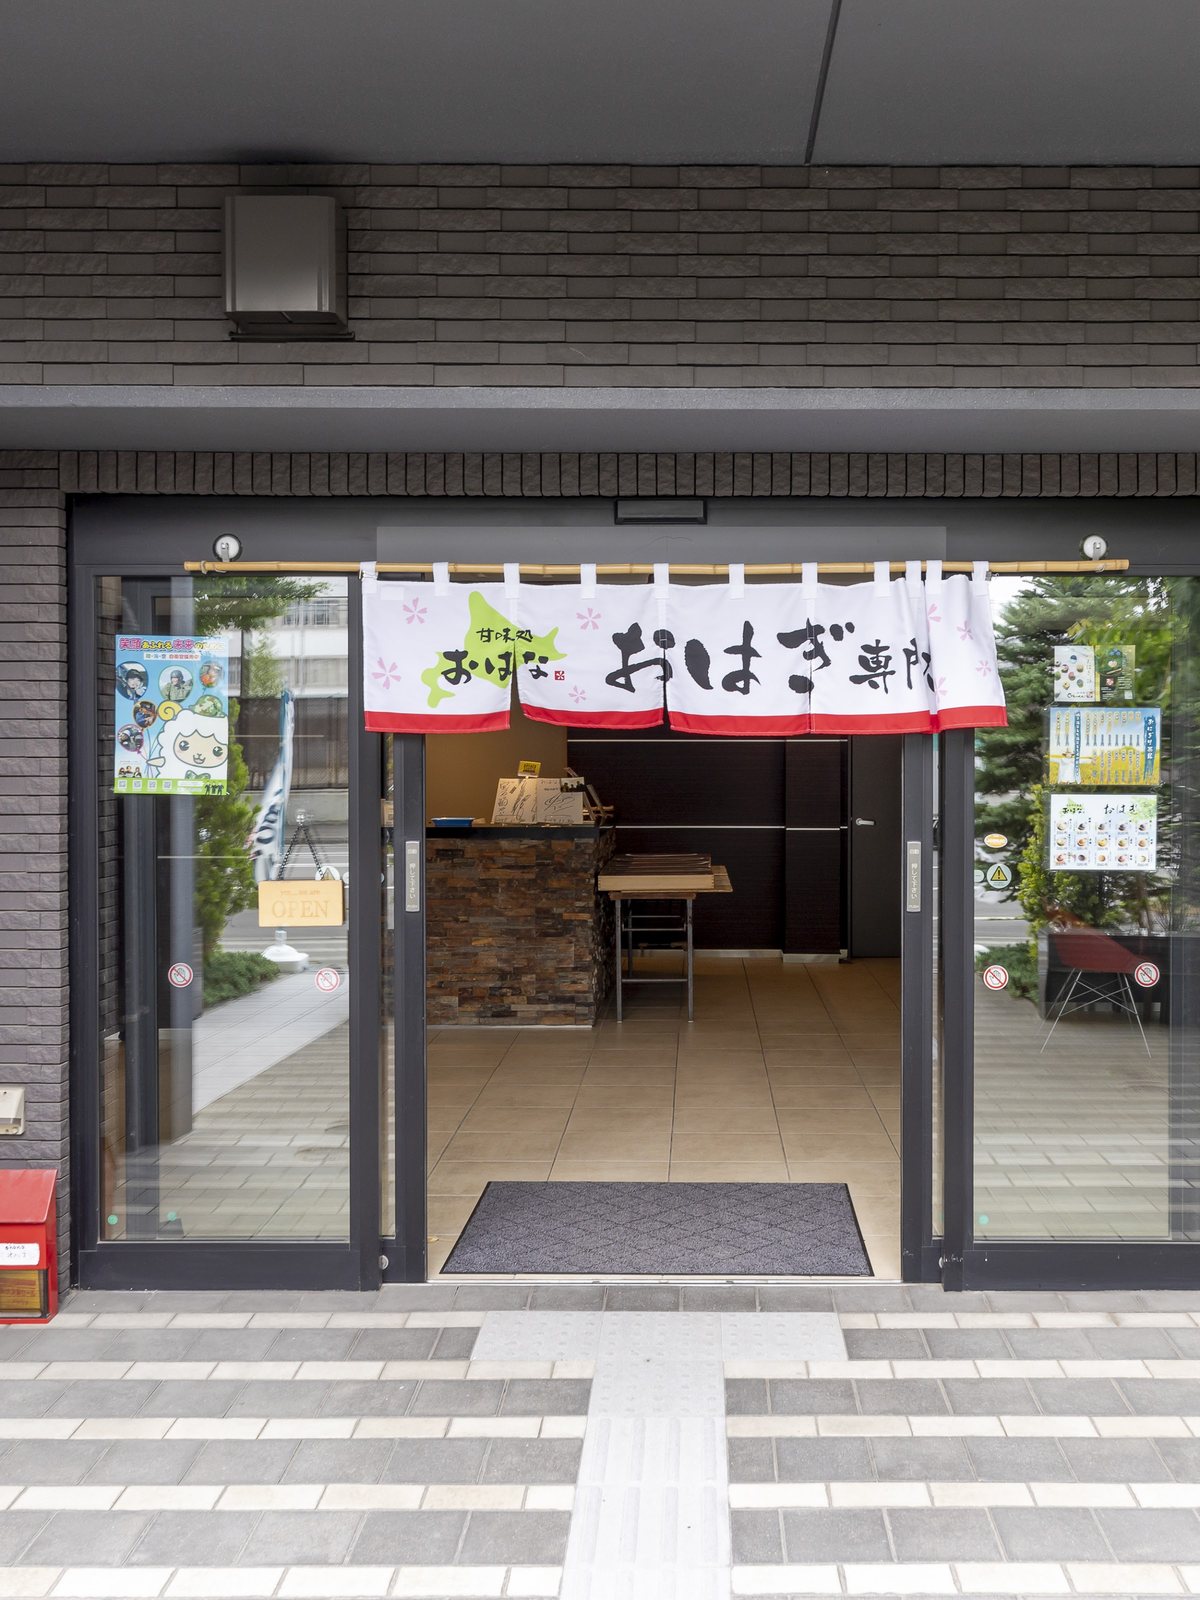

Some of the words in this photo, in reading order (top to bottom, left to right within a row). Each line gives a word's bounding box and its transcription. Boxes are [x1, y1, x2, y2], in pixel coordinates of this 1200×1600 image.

[476, 628, 534, 644] 甘味処
[441, 649, 550, 685] おはな
[272, 900, 330, 919] OPEN
